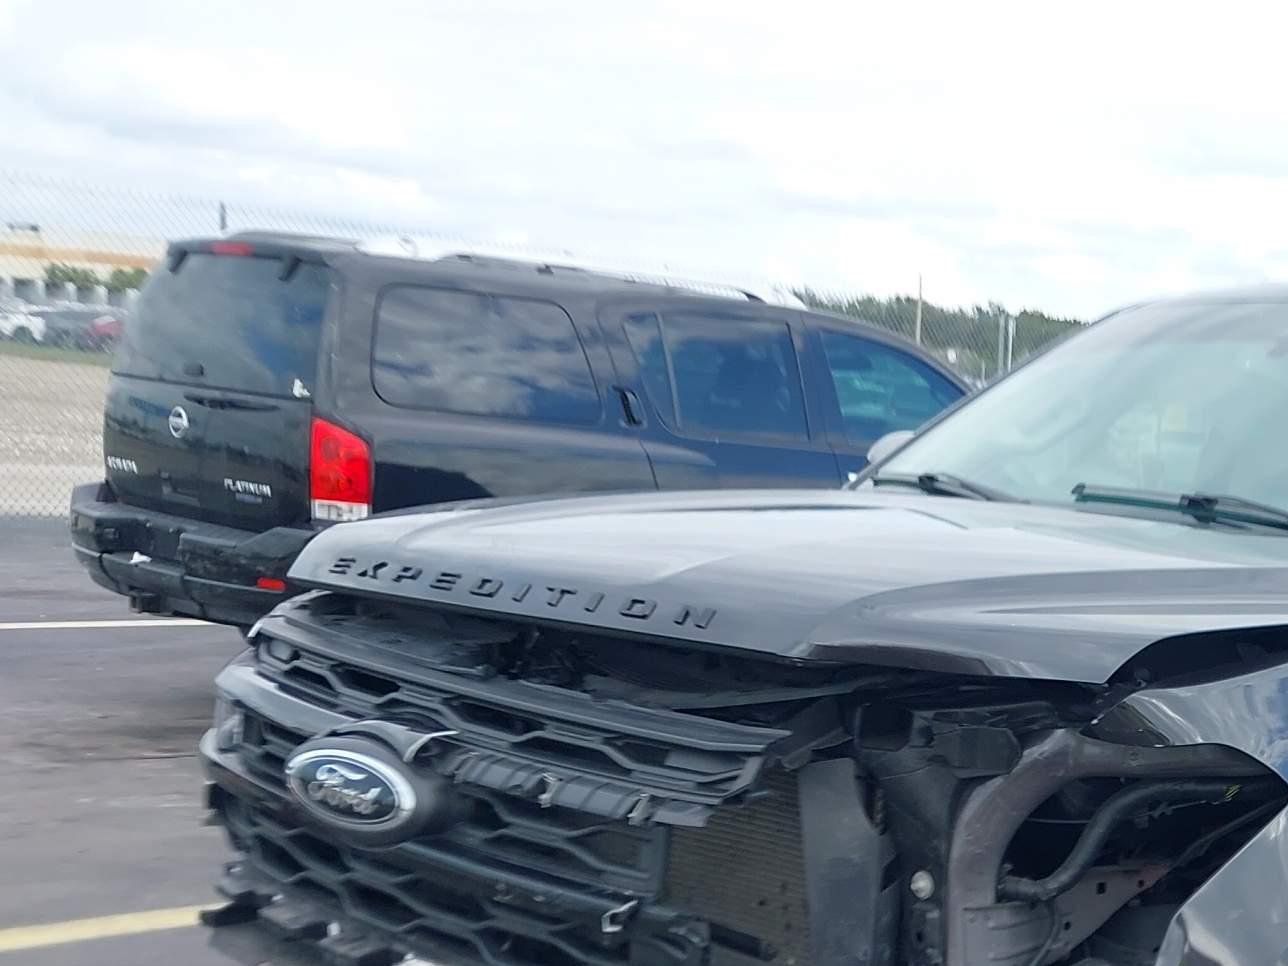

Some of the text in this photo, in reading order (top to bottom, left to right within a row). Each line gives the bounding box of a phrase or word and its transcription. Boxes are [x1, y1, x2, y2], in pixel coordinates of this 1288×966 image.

[223, 477, 272, 497] PLATINUM
[328, 556, 718, 630] EXPEDITION
[308, 764, 383, 815] Ford
